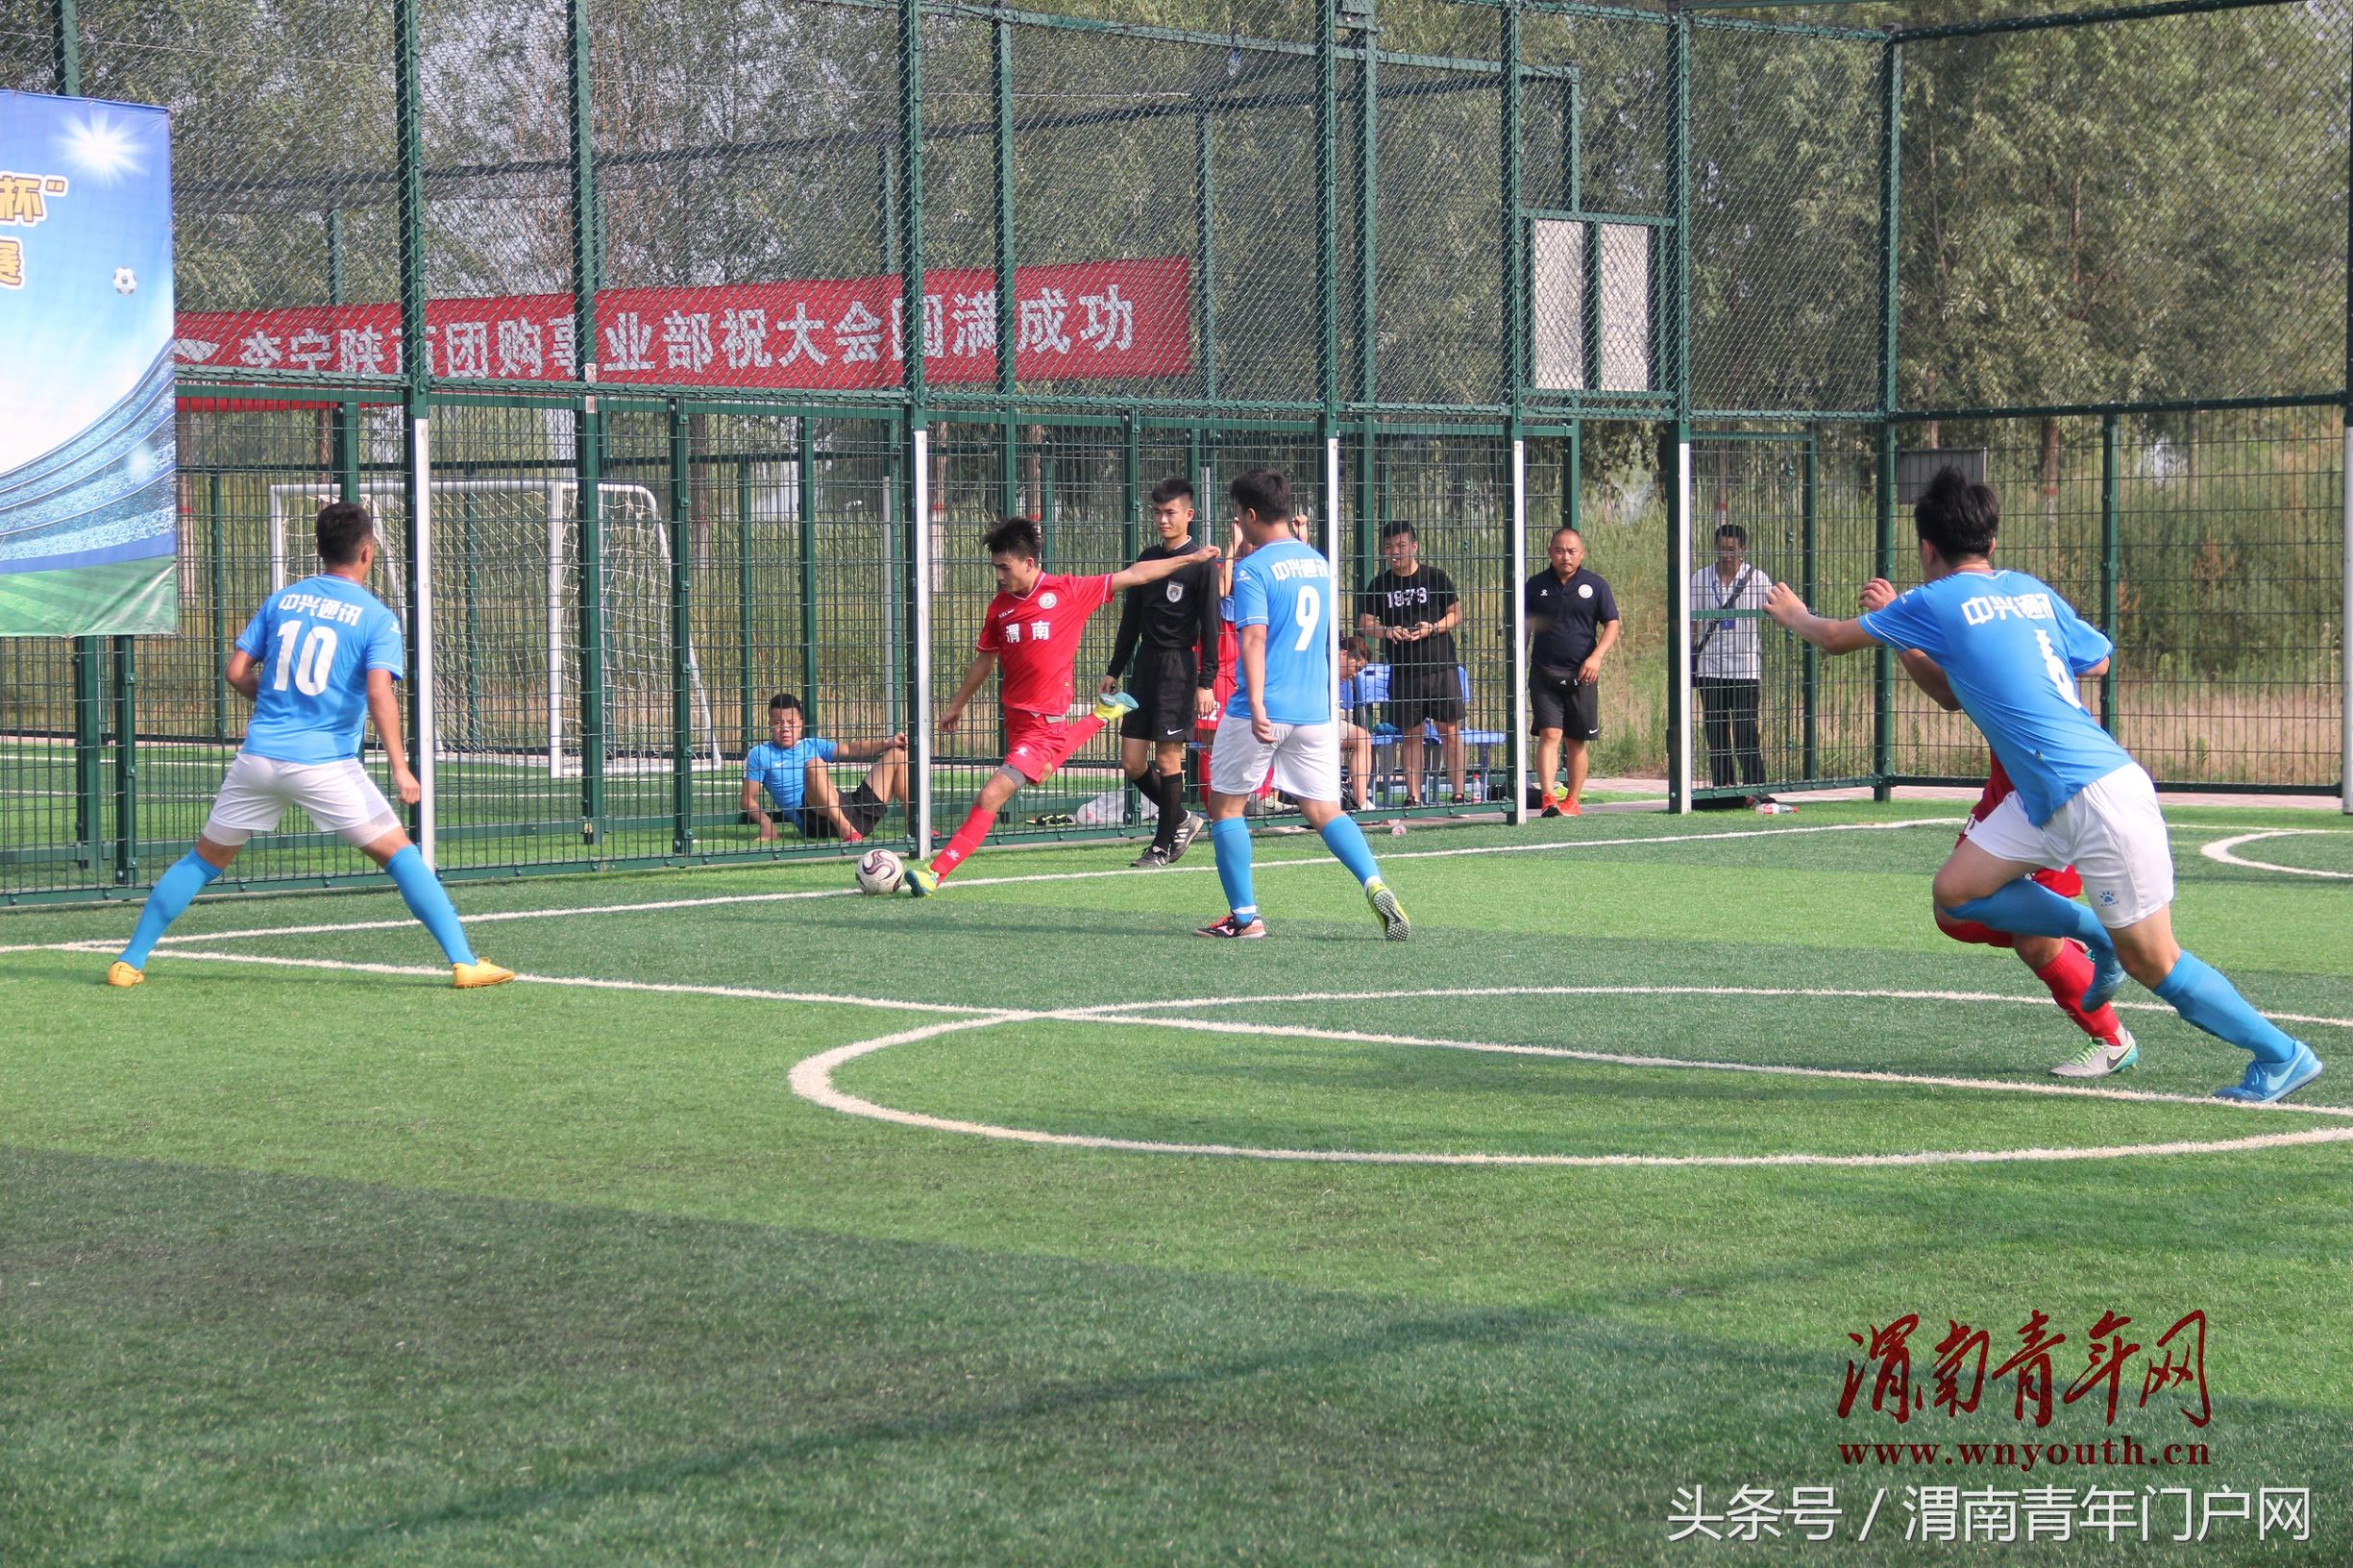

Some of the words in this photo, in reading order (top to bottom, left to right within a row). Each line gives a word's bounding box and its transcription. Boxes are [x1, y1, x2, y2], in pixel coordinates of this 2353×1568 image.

[278, 593, 363, 626] 中兴通讯
[1294, 585, 1321, 651] 9
[274, 619, 338, 697] 10
